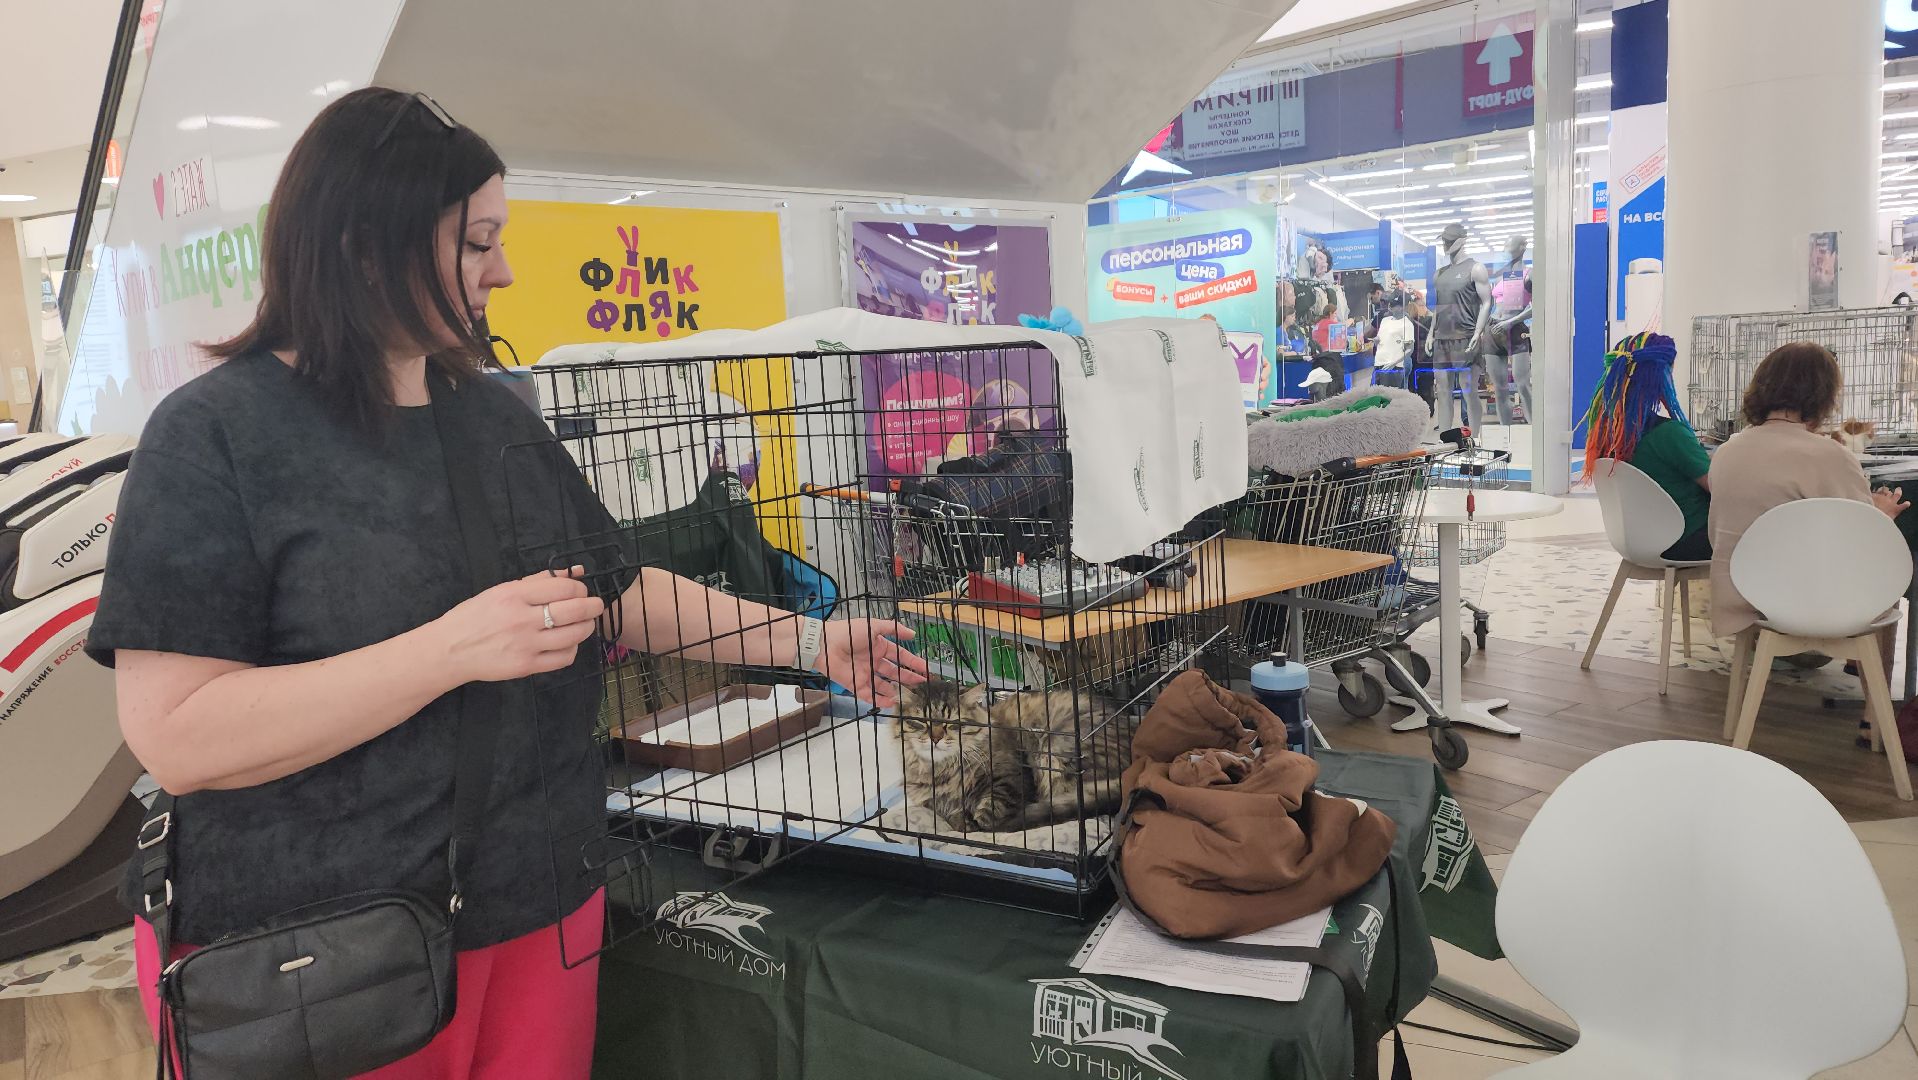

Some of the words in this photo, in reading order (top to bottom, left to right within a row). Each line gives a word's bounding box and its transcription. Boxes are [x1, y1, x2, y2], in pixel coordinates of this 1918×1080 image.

[1623, 213, 1642, 224] НА
[1109, 233, 1243, 270] персональная
[1181, 264, 1218, 280] цена
[580, 257, 699, 298] ФЛИК
[586, 290, 700, 333] ФЛЯК
[51, 522, 108, 569] ТОЛЬКО
[0, 665, 54, 720] НАПРЯЖЕНИЕ
[653, 925, 735, 967] УЮТНЫЙ
[738, 953, 787, 981] ДОМ
